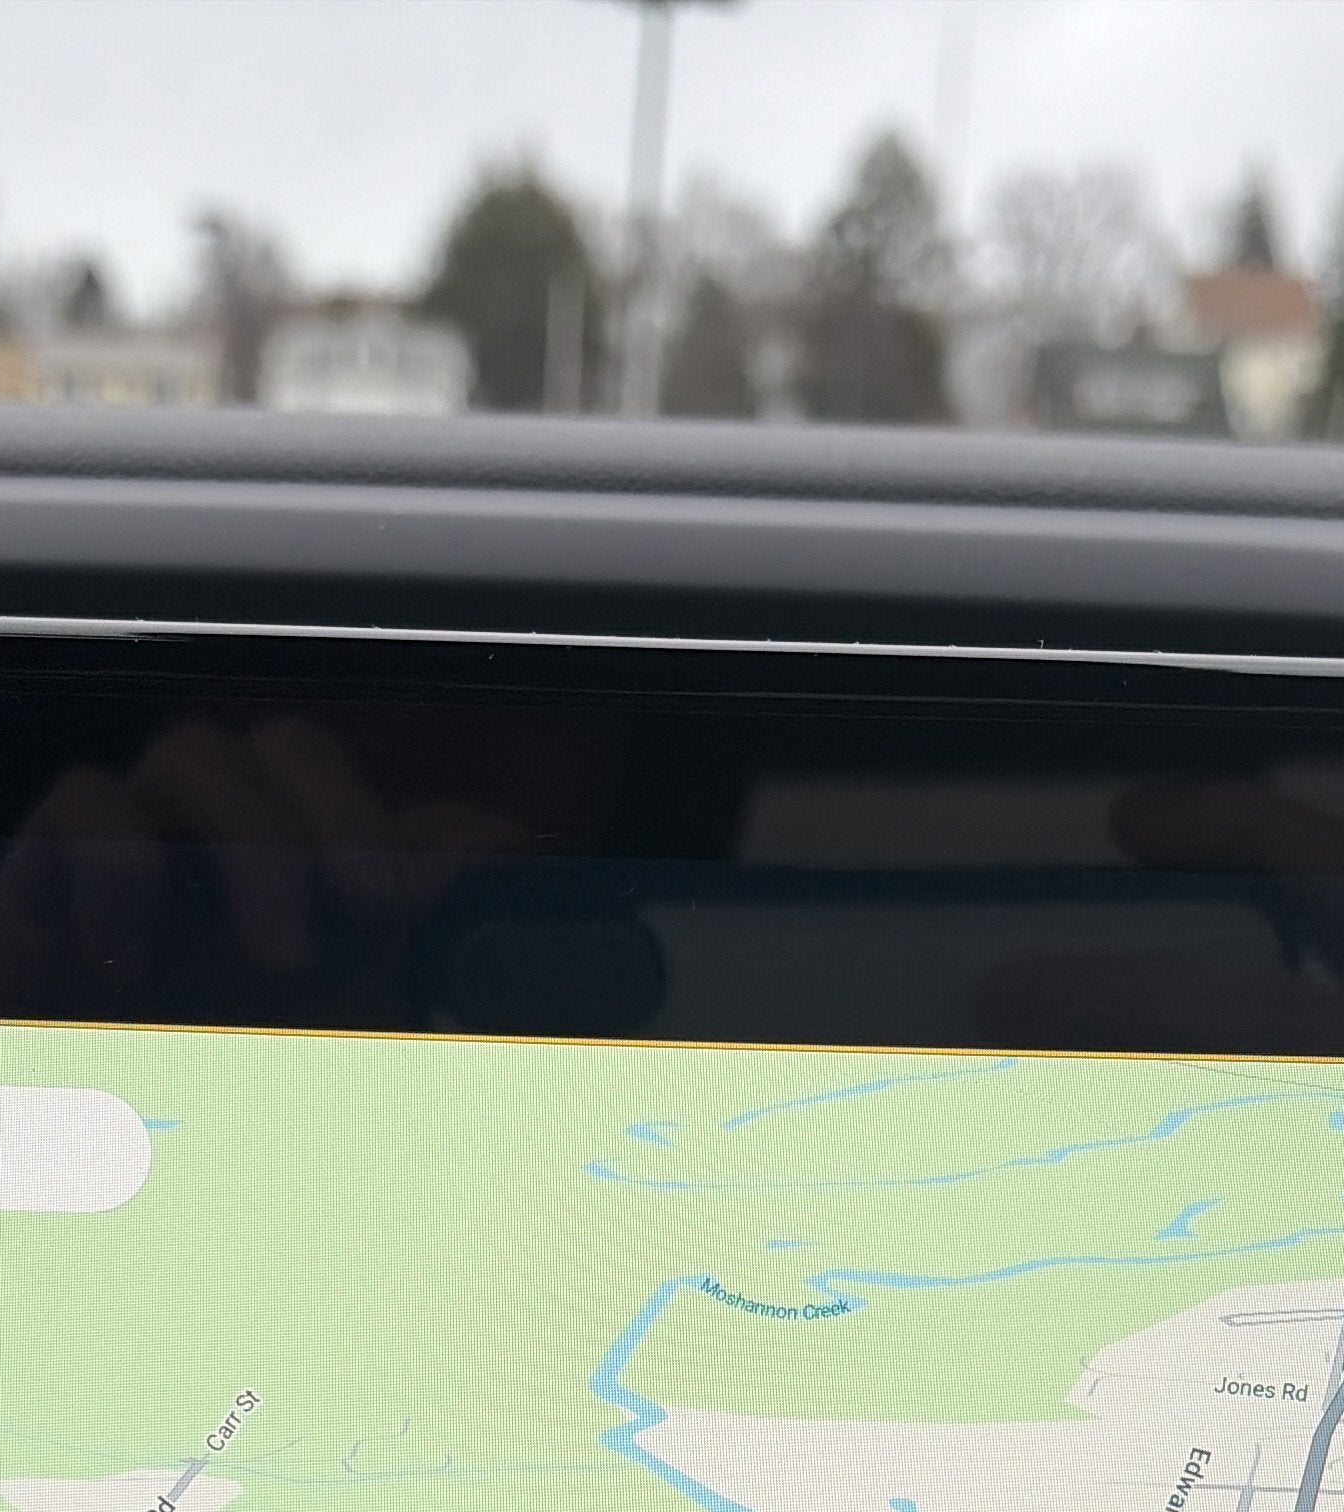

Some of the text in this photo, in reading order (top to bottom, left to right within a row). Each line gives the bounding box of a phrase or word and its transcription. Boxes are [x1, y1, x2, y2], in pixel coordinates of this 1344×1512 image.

[701, 1277, 851, 1321] Moshannon Creek
[1214, 1378, 1308, 1402] Jones Rd
[205, 1389, 261, 1454] Carr St
